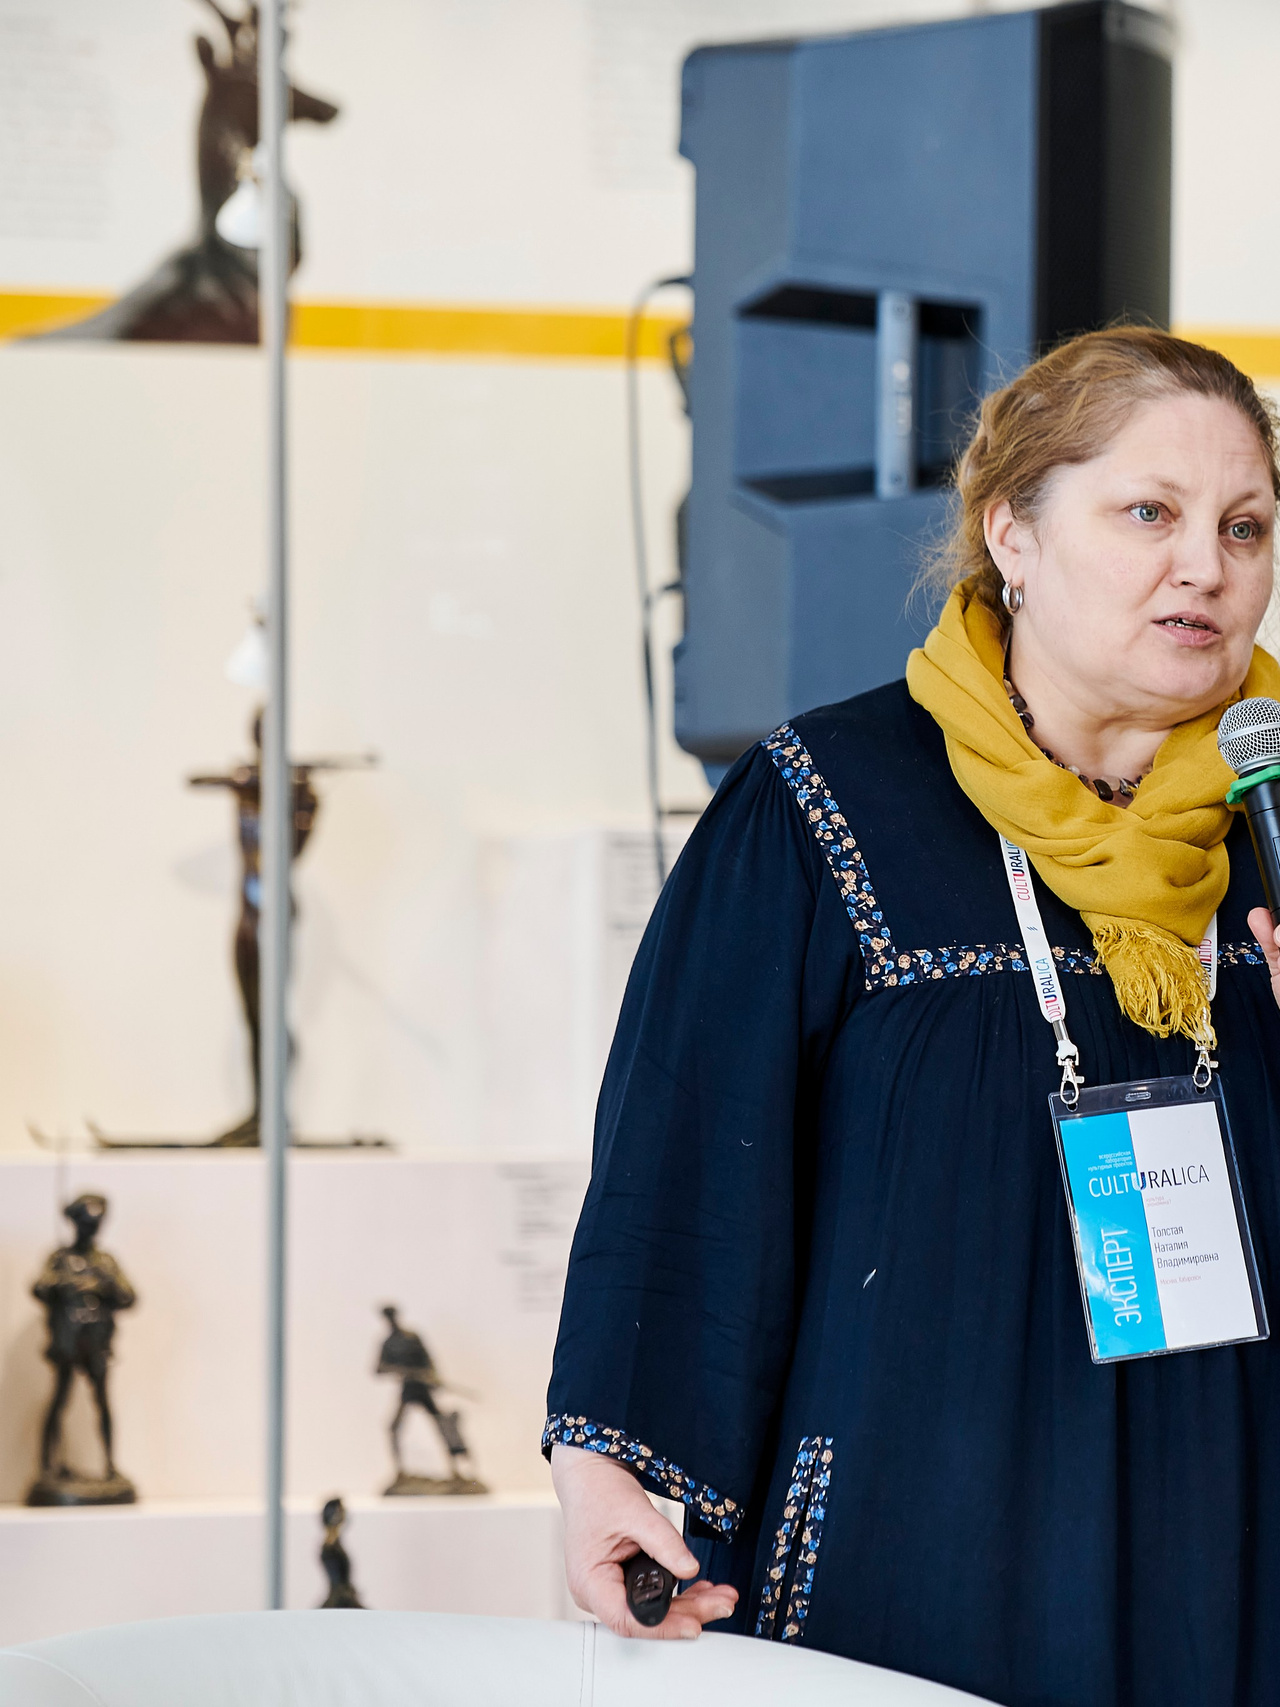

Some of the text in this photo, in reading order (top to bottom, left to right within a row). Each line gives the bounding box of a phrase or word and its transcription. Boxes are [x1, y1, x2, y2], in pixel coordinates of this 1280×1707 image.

[1005, 839, 1031, 901] CULTURALIC
[1036, 957, 1063, 1019] ULTURALICA
[1088, 1164, 1210, 1198] CULTURALICA
[1151, 1224, 1184, 1238] Толстая
[1153, 1240, 1189, 1253] Наталия
[1101, 1228, 1142, 1327] ЭКСПЕРТ
[1156, 1251, 1220, 1270] Владимировна
